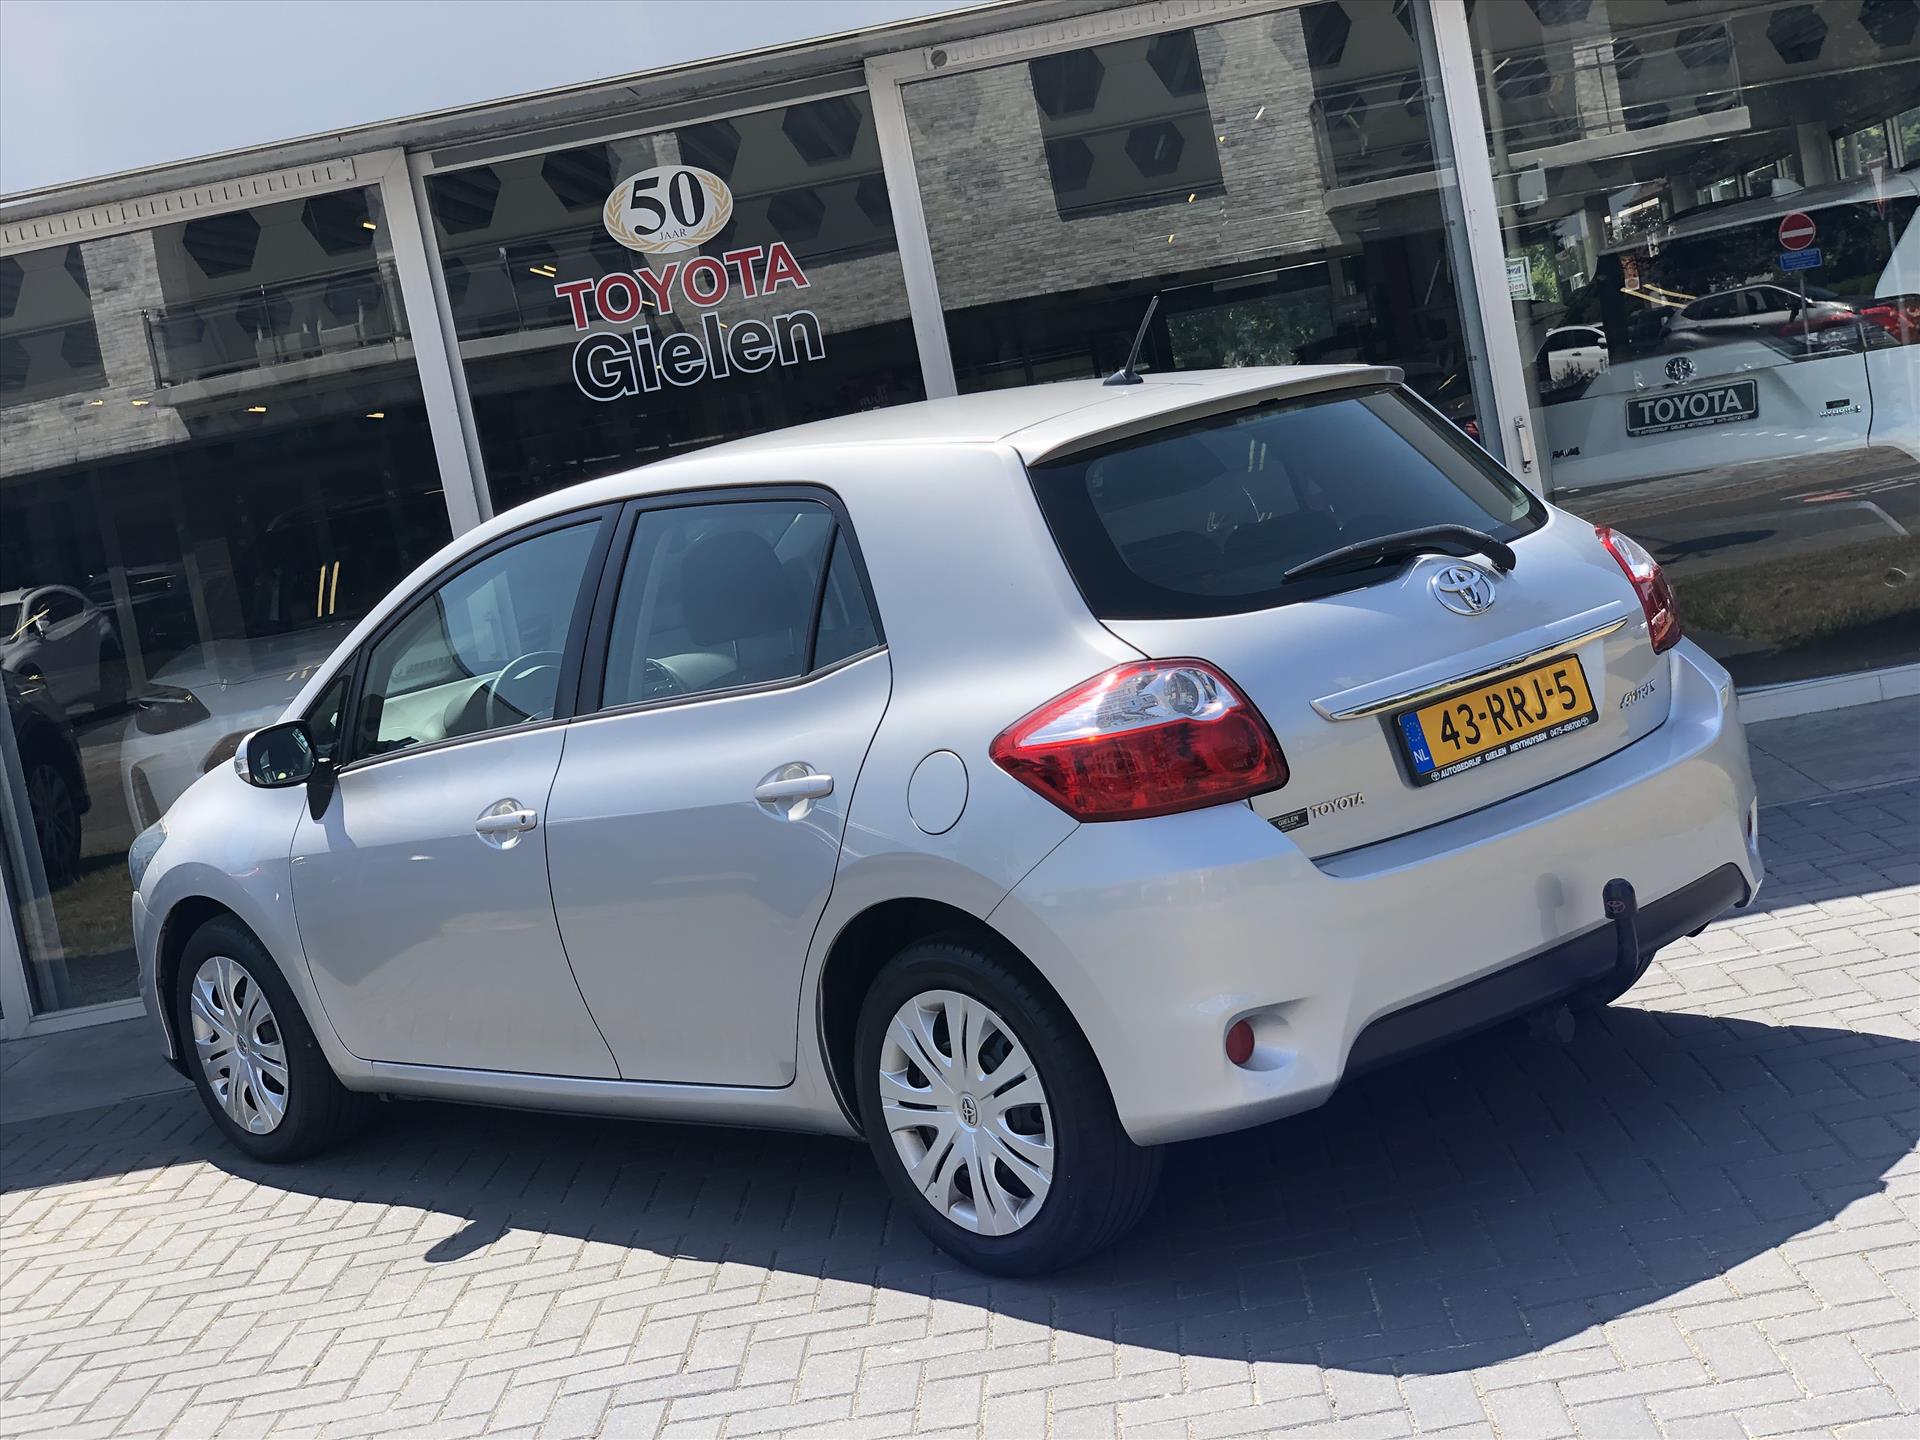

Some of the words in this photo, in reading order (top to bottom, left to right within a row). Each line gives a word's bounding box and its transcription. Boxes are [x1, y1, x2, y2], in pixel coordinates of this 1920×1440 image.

[629, 170, 706, 236] 50
[659, 228, 688, 241] JAAR
[554, 241, 811, 331] TOYOTA
[572, 310, 826, 401] Gielen
[1638, 388, 1743, 425] TOYOTA
[1440, 669, 1577, 750] 43-RRJ-5
[1414, 748, 1430, 764] NL
[1440, 756, 1482, 778] AUTOBEDRIJF
[1485, 747, 1507, 761] GIELEN
[1510, 731, 1547, 752] HEYTHUYSEN
[1277, 815, 1299, 826] GIELEN
[1309, 792, 1365, 819] TOYOTA
